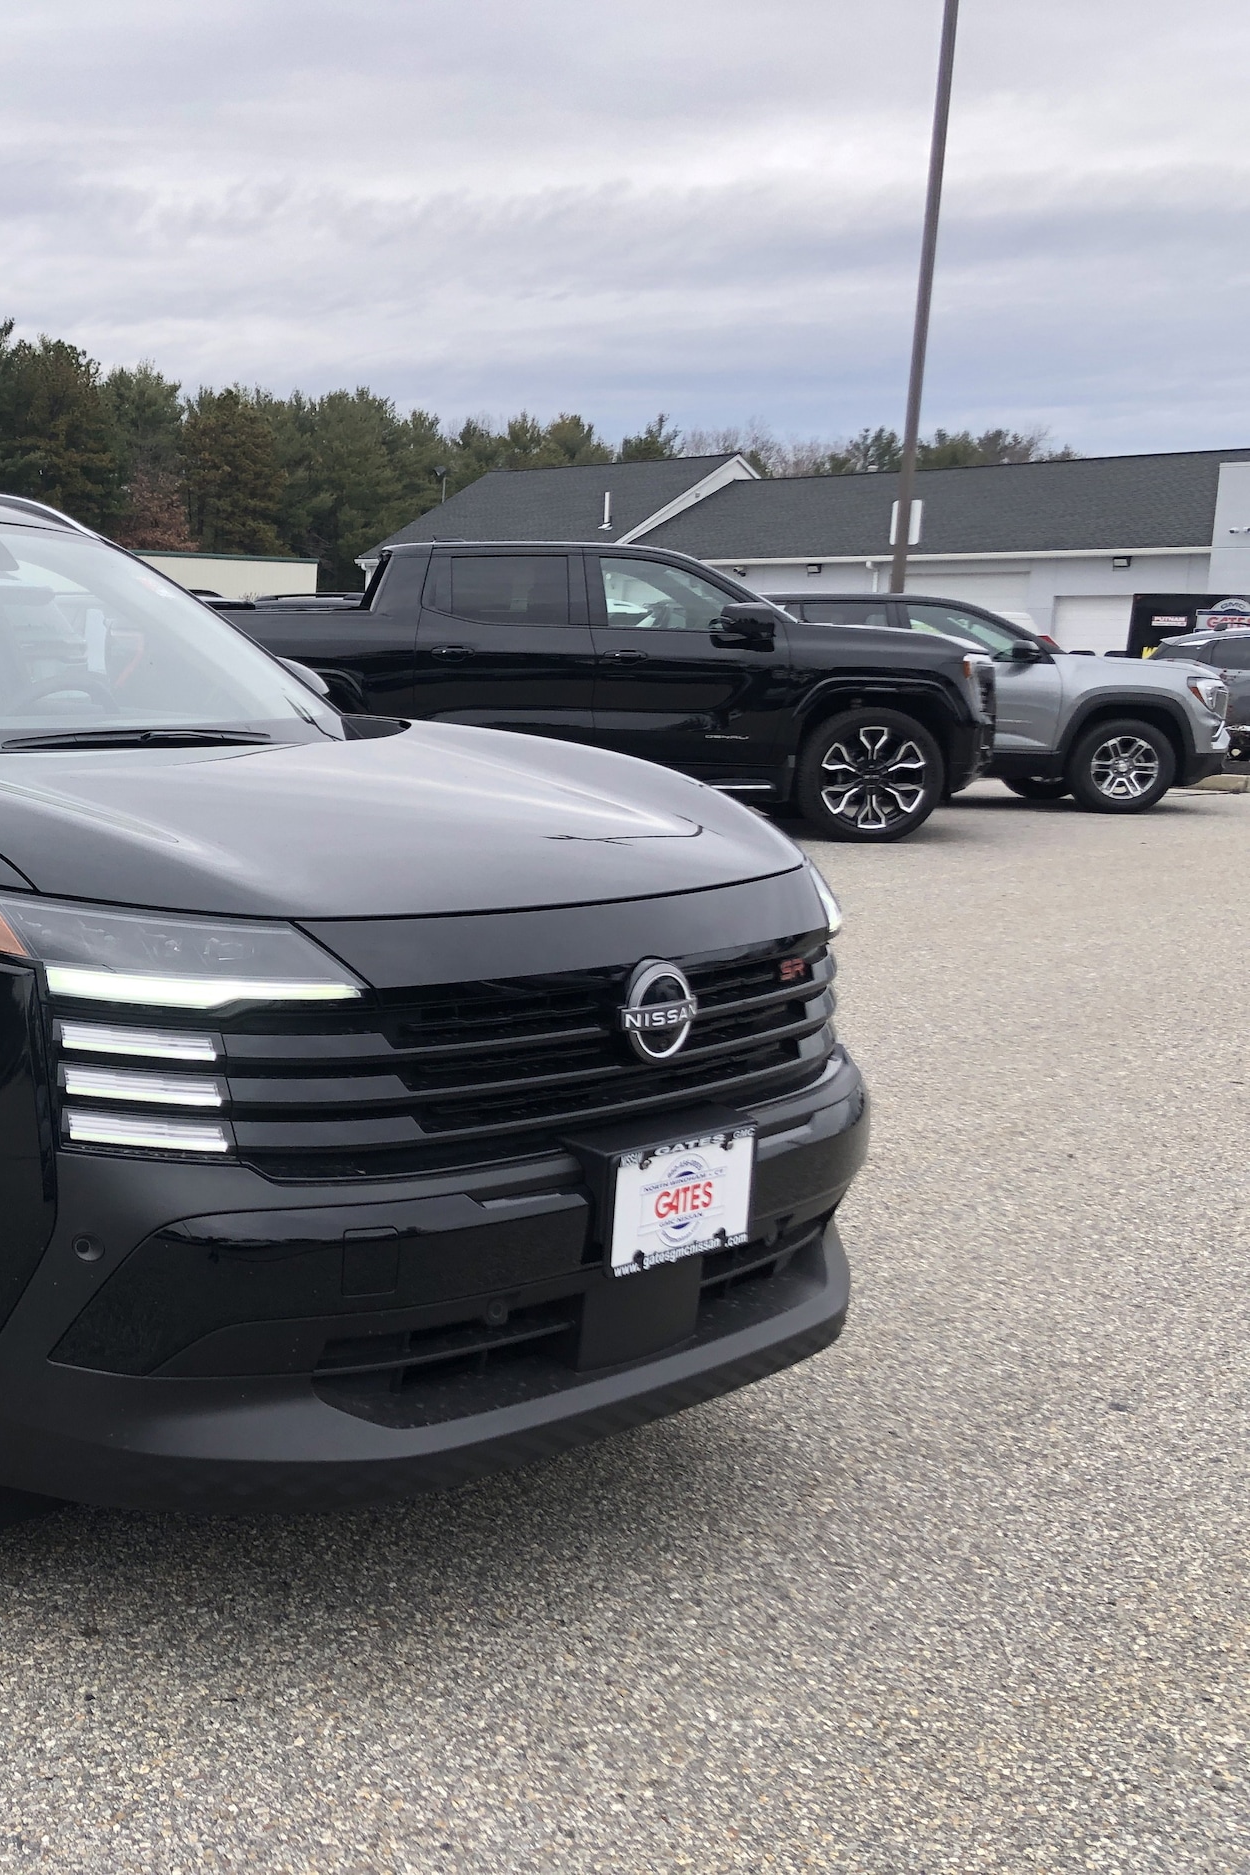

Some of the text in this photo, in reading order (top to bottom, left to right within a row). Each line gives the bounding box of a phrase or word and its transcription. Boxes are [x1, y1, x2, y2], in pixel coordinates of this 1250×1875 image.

[1207, 616, 1250, 628] GATE
[625, 1004, 697, 1028] NISSAN
[654, 1134, 726, 1156] GATES
[733, 1127, 755, 1139] GMC
[654, 1181, 713, 1219] GATES
